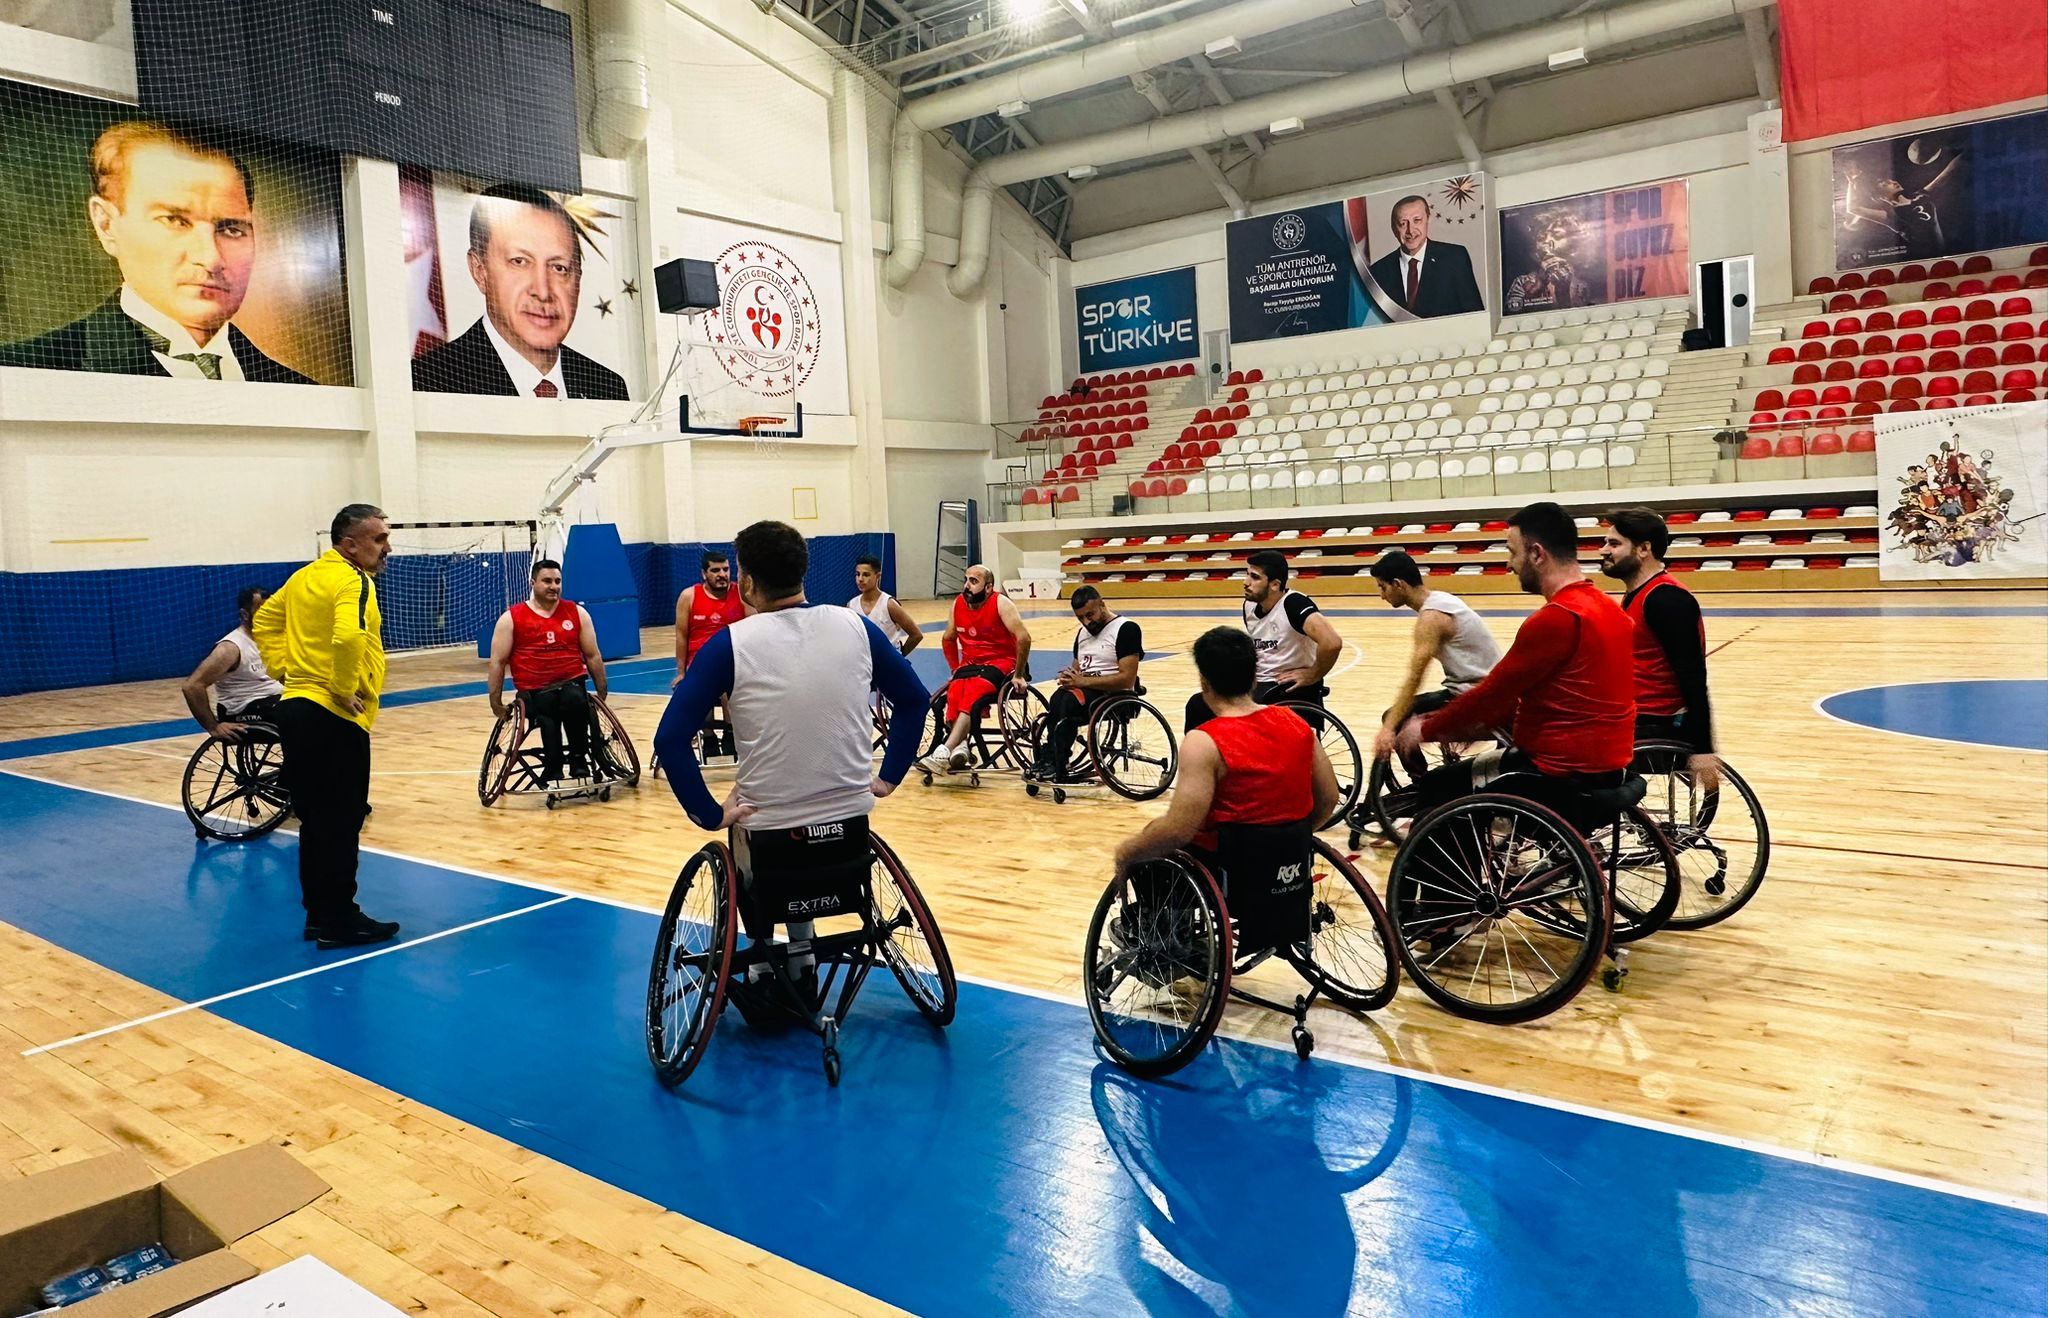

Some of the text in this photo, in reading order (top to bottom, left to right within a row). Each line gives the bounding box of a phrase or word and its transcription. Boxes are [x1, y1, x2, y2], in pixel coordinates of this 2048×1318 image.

[371, 8, 394, 26] TIME
[374, 91, 401, 106] PERIOD
[1246, 262, 1338, 286] VE SPORCULARIMIZA
[1255, 254, 1327, 275] TÜM ANTRENÖR
[1249, 274, 1335, 295] BAŞARILAR DİLİYORUM
[789, 299, 801, 325] SPOR
[1082, 294, 1152, 327] SPOR
[1083, 319, 1193, 356] TÜRKİYE
[1028, 582, 1037, 599] 1
[546, 631, 556, 644] 9
[1276, 862, 1302, 884] RGK
[788, 894, 840, 911] EXTRA
